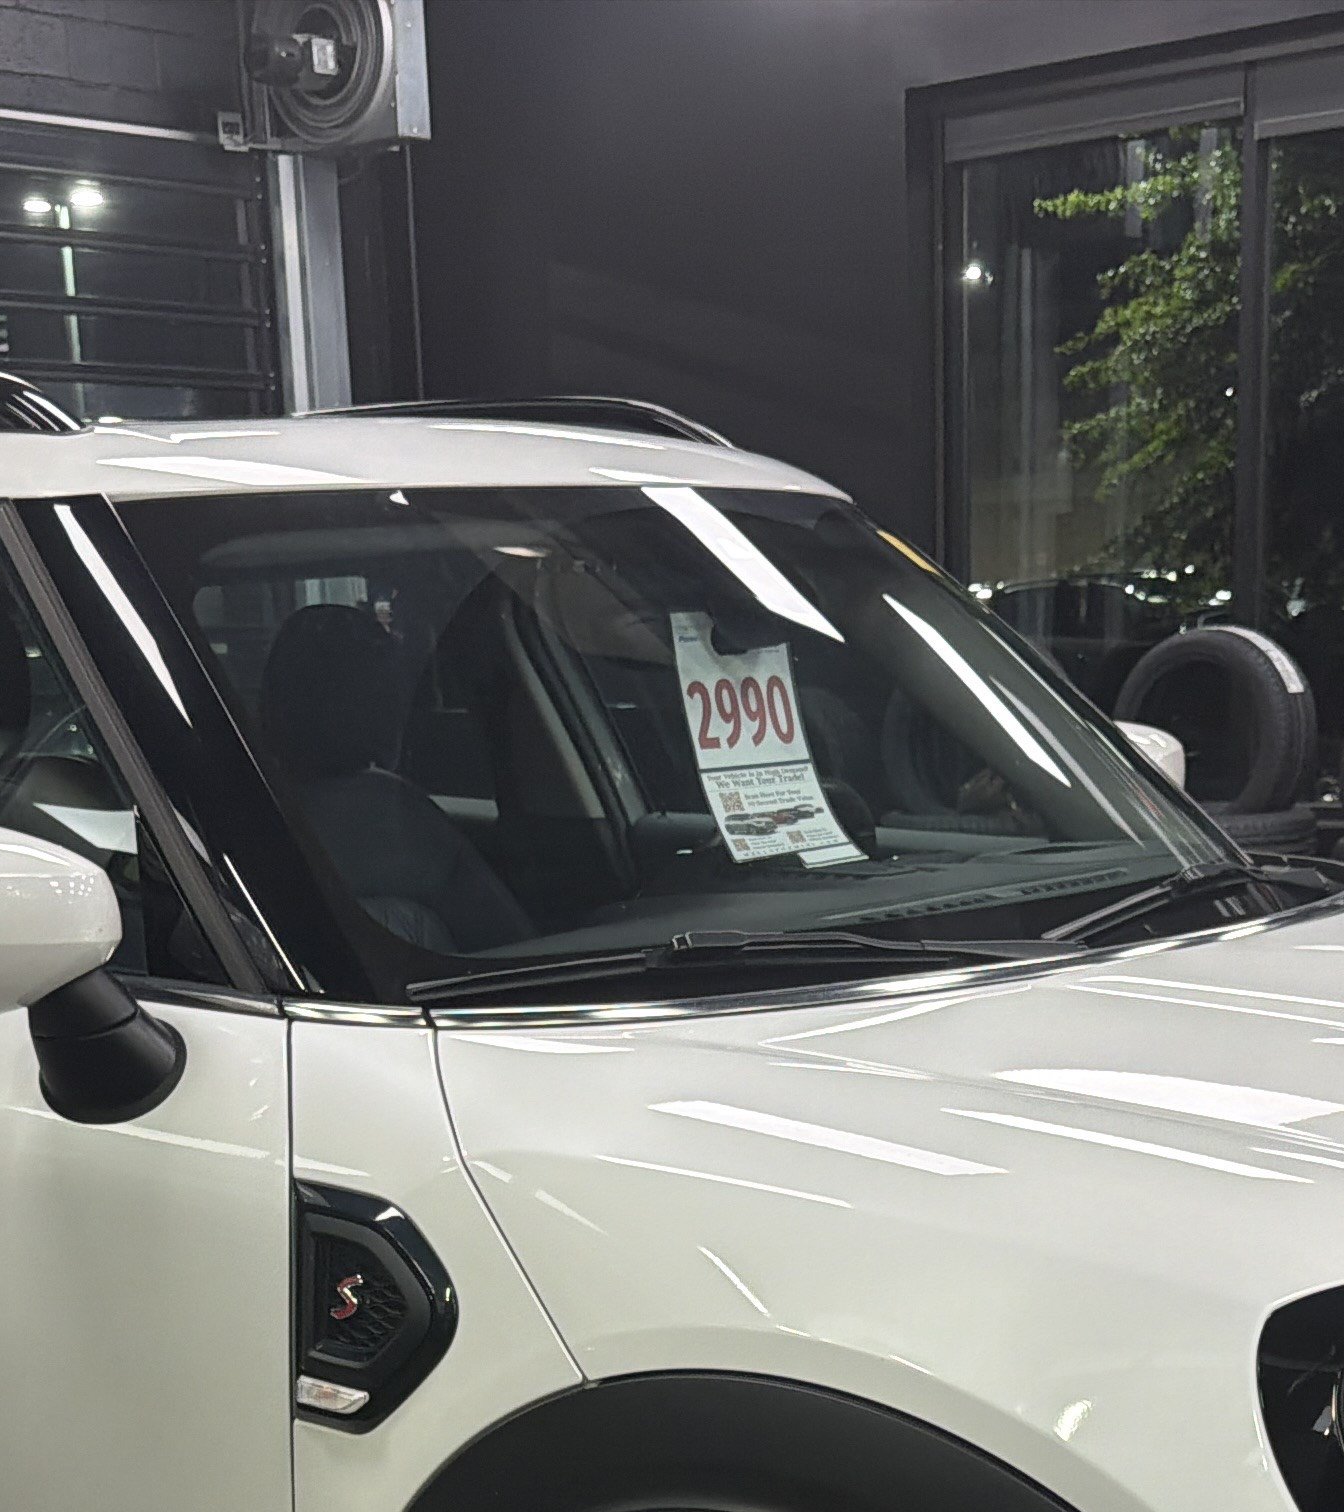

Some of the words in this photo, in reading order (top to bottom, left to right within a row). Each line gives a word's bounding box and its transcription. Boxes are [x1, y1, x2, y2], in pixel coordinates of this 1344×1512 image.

[686, 674, 795, 750] 2990
[731, 778, 755, 787] Want
[755, 776, 777, 785] Your
[330, 1273, 364, 1320] S
